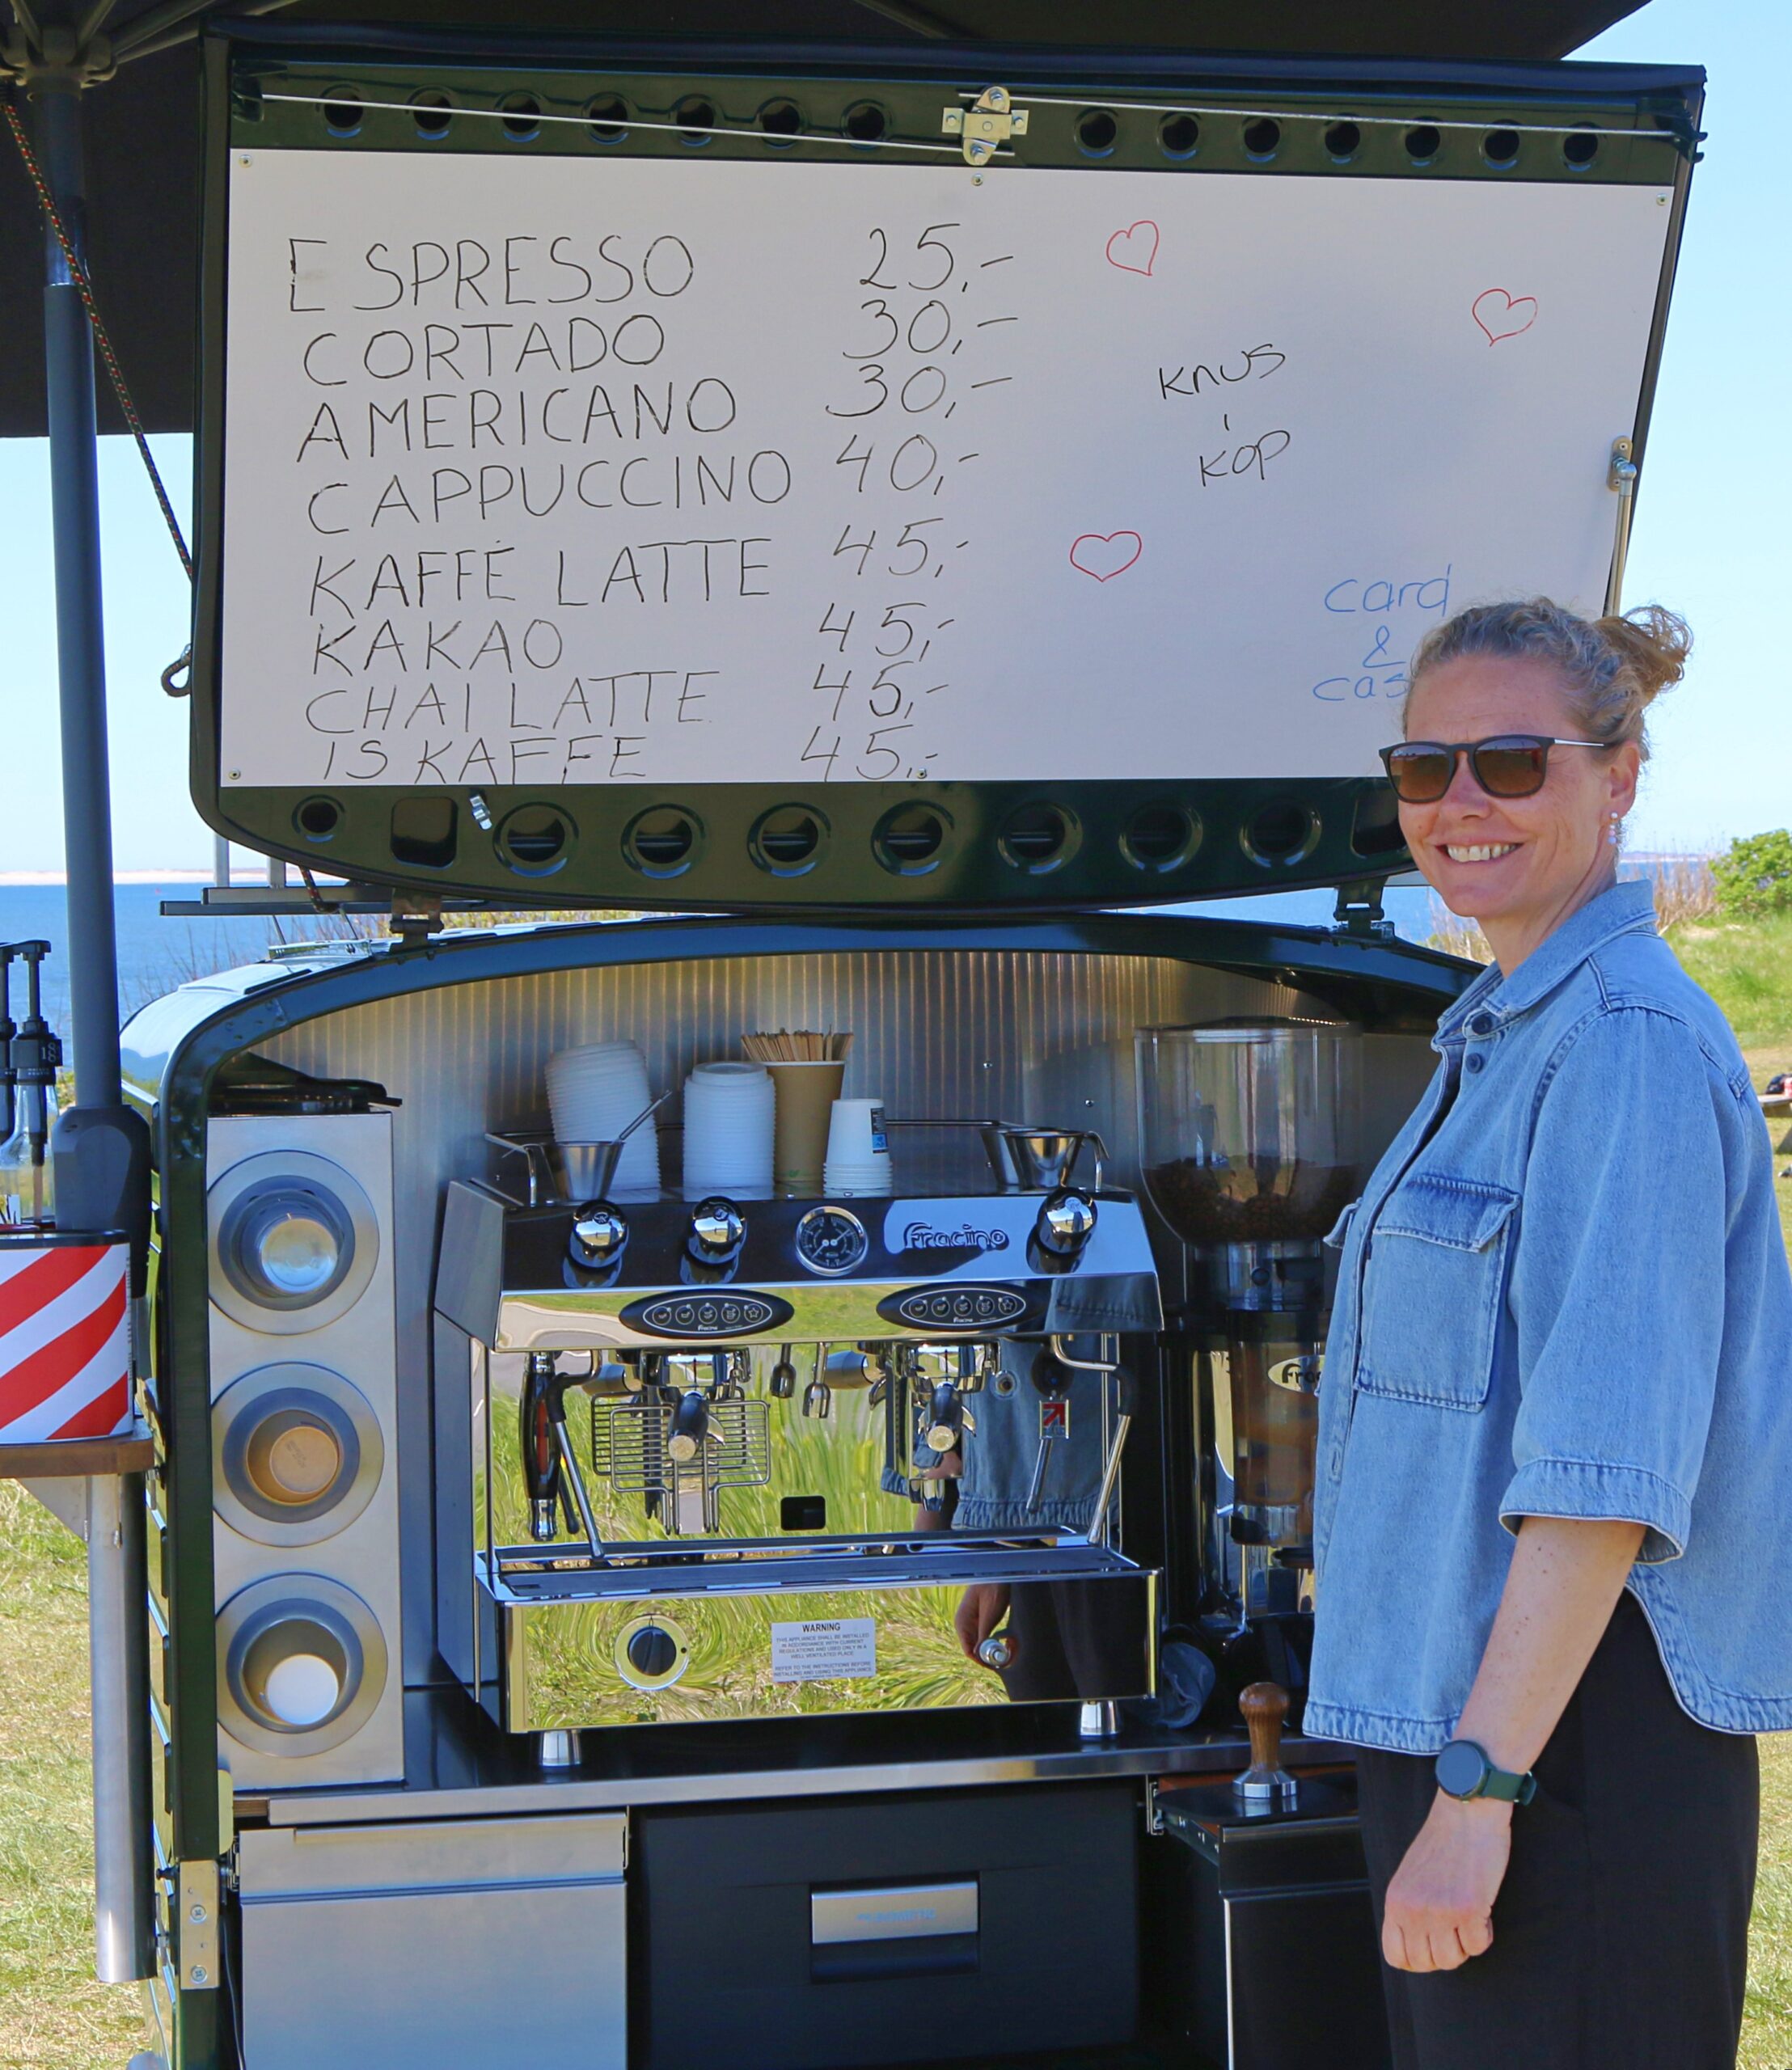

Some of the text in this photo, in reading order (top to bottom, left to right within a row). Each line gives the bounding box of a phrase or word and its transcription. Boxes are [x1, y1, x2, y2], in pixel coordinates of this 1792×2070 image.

[289, 235, 694, 312] ESPRESSO
[304, 315, 664, 386] CORTADO
[297, 378, 737, 463] AMERICANO
[308, 450, 791, 534] CAPPUCCINO
[558, 539, 771, 606] LATTE
[1325, 564, 1452, 617] card
[313, 619, 562, 677] KAKAO
[1363, 625, 1407, 668] &
[306, 682, 470, 733] CHAI
[510, 671, 720, 729] LATTE
[1312, 673, 1410, 701] cas
[323, 740, 388, 780] IS
[414, 734, 646, 784] KAFFE
[903, 1222, 1009, 1251] Fracino
[802, 1623, 841, 1633] WARNING
